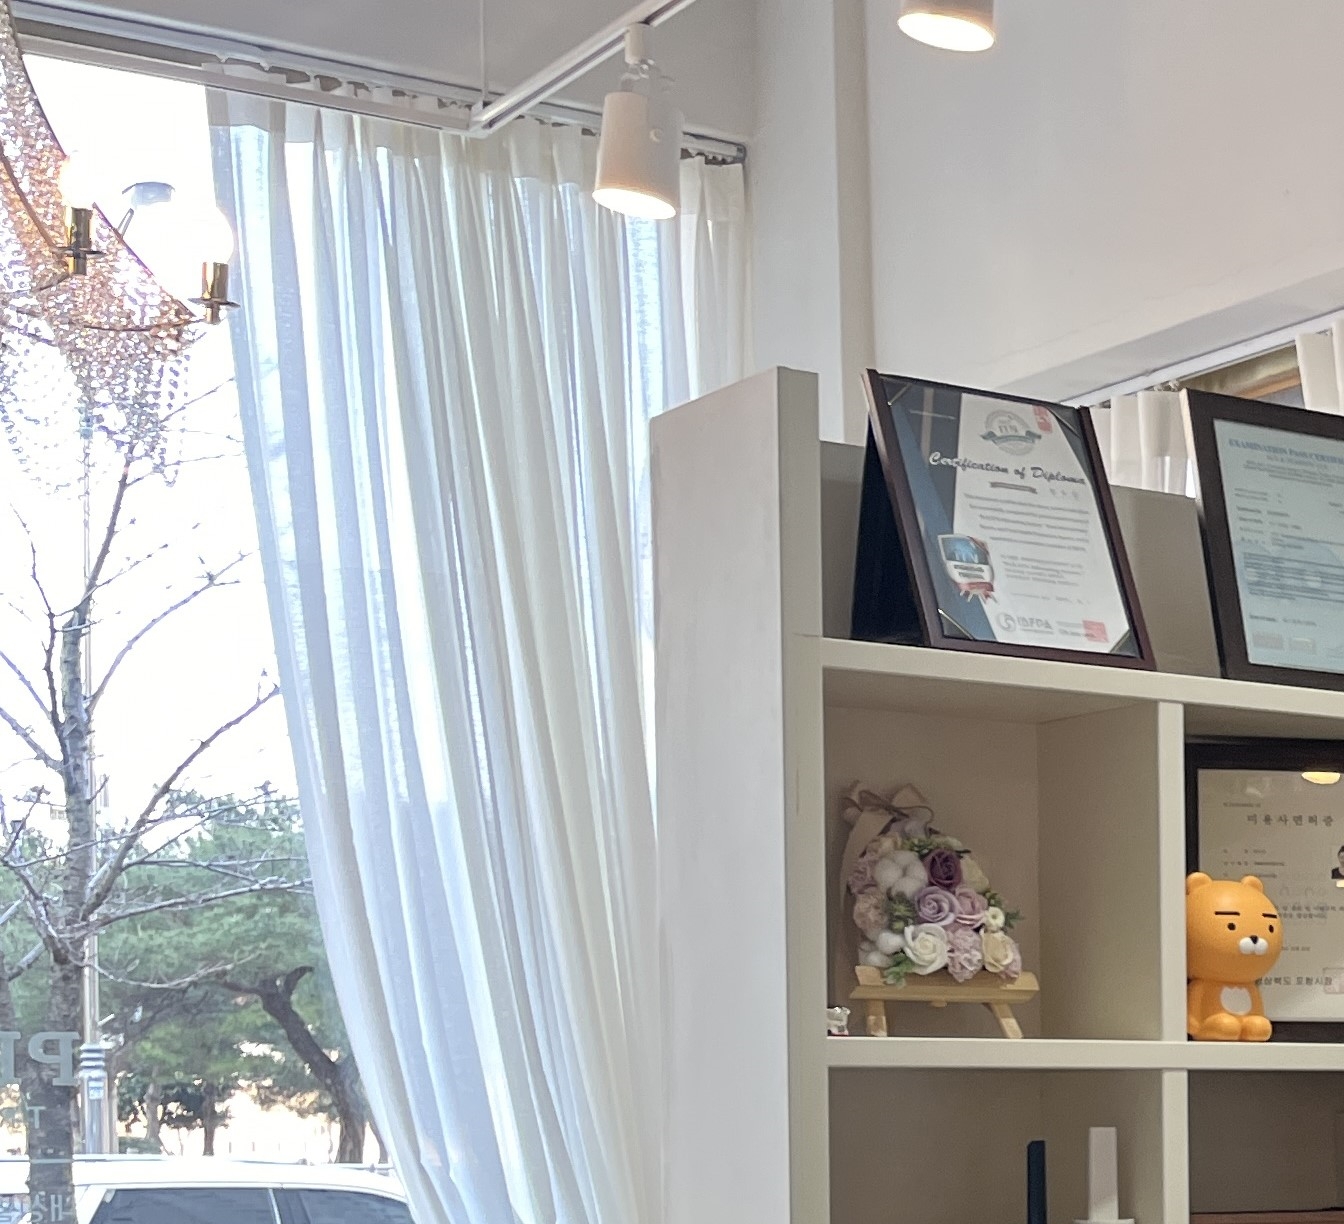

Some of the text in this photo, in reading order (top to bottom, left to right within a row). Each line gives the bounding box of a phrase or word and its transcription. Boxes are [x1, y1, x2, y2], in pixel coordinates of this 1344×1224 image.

[929, 451, 1086, 485] Certification of Diploma
